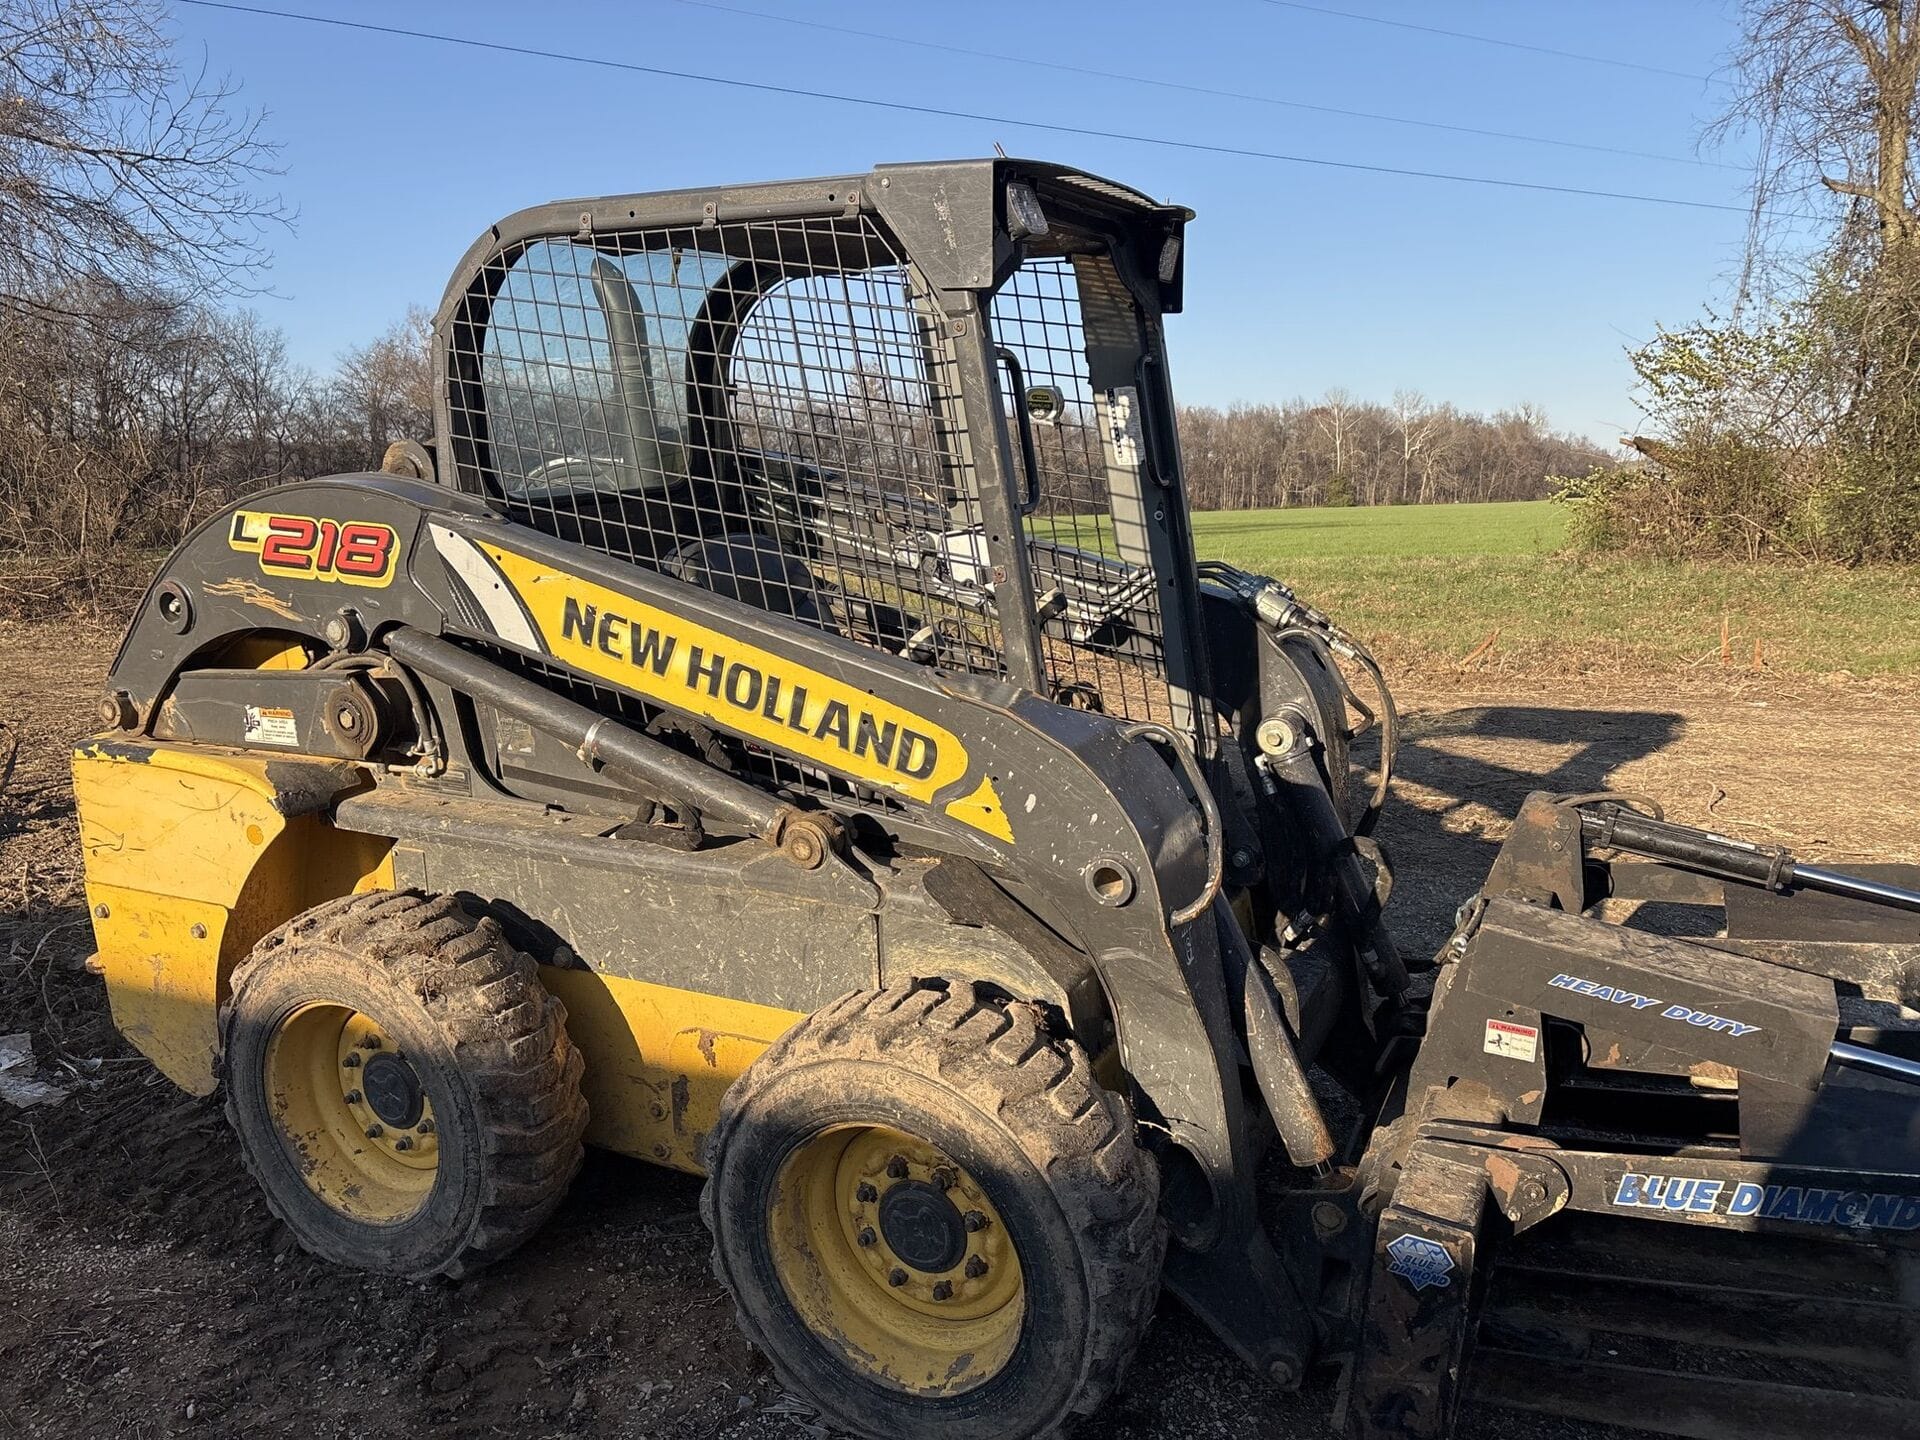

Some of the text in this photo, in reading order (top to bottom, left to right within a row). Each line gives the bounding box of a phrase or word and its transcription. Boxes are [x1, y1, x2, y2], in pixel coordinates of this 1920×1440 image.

[561, 596, 937, 780] NEW HOLLAND
[1548, 974, 1762, 1037] HEAVY DUTY
[1502, 1025, 1532, 1035] WARNING
[1613, 1172, 1920, 1231] BLUE DIAMOND
[1390, 1262, 1446, 1286] DIAMOND
[1403, 1255, 1436, 1270] BLUE
